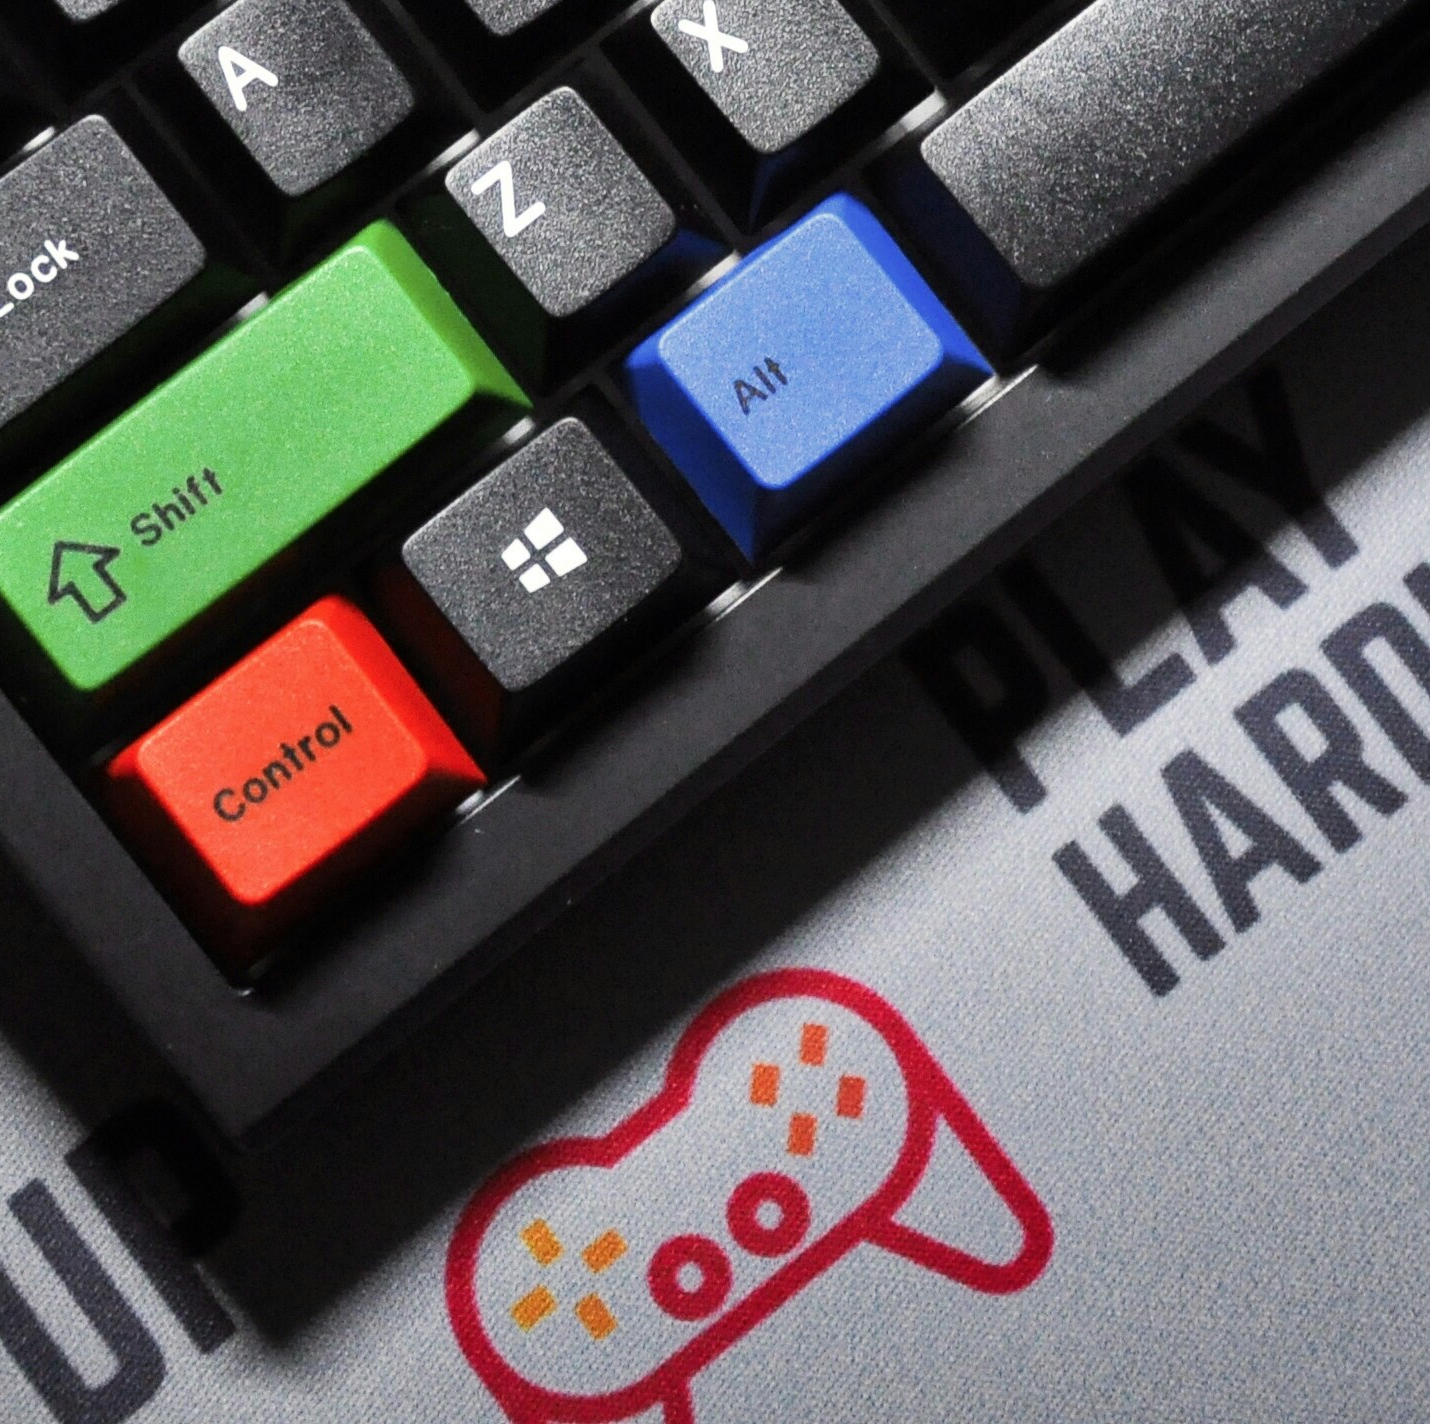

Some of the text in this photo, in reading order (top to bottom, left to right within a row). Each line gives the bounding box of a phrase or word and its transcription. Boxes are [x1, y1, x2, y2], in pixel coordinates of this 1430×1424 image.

[216, 44, 280, 113] A
[469, 159, 548, 241] Z
[733, 357, 788, 415] Alt
[129, 467, 224, 548] Shift
[898, 360, 1361, 816] PLAY
[211, 704, 354, 824] Control
